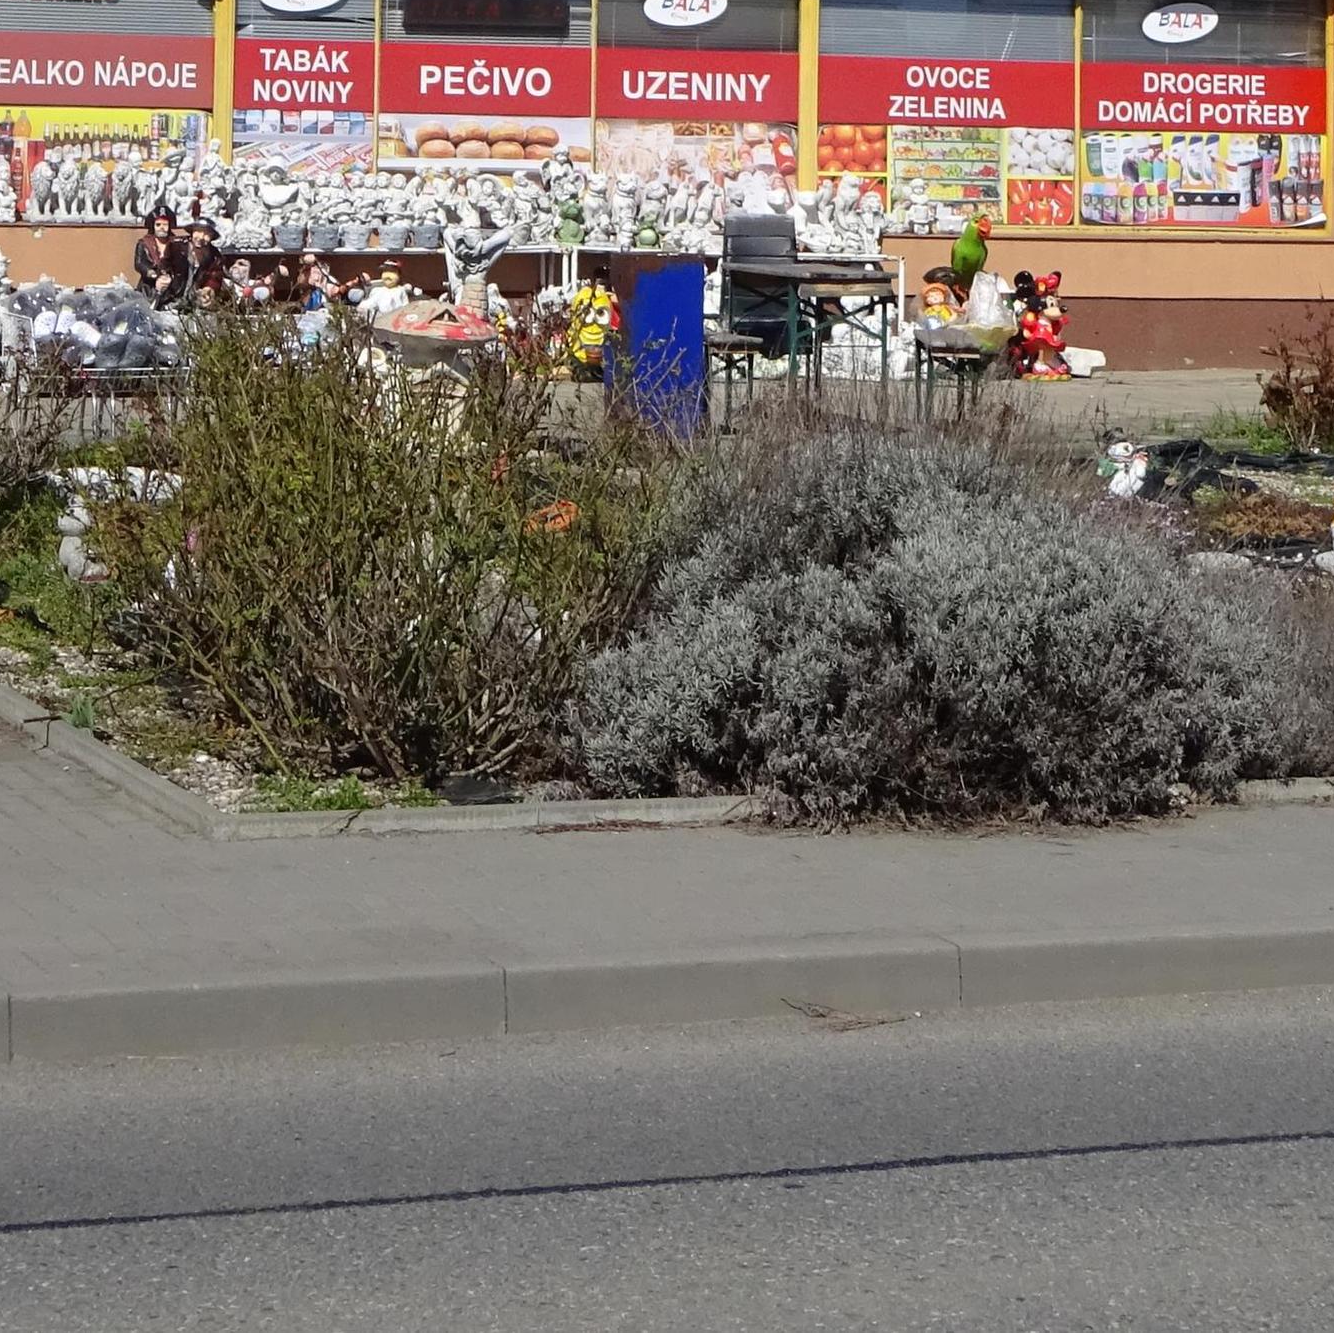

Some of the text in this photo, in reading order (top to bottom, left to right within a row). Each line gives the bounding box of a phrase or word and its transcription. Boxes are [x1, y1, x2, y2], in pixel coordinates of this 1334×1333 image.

[94, 55, 197, 89] NÁPOJE
[259, 44, 350, 73] TABÁK
[253, 78, 354, 104] NOVINY
[420, 59, 552, 97] PEČIVO
[622, 70, 771, 102] UZENINY
[906, 65, 990, 89] OVOCE
[1143, 72, 1266, 96] DROGERIE
[888, 95, 1006, 120] ZELENINA
[1098, 97, 1310, 126] DOMÁCÍ POTŘEBY
